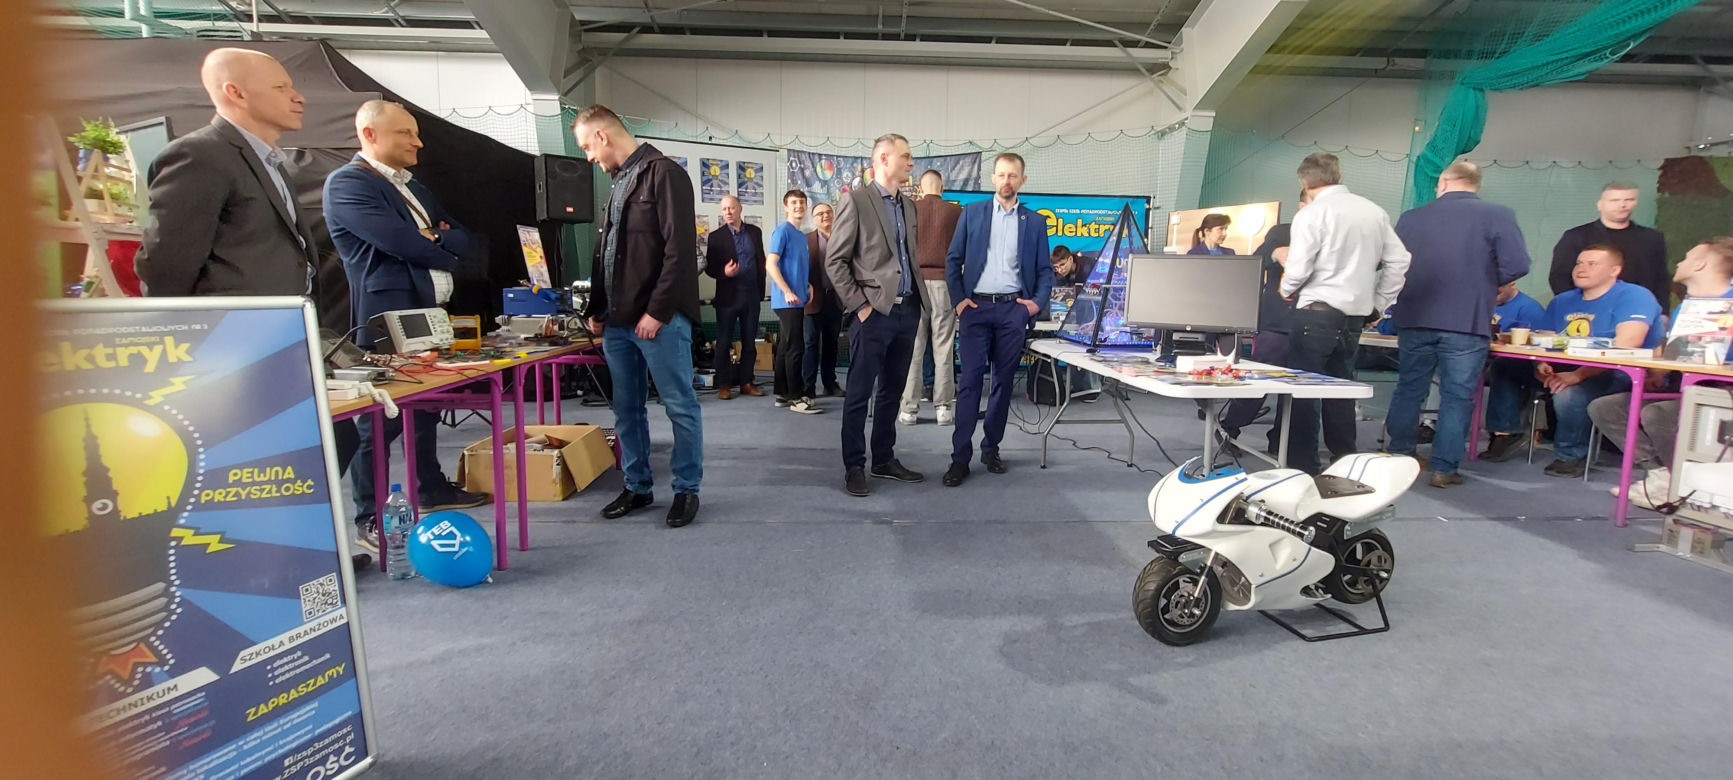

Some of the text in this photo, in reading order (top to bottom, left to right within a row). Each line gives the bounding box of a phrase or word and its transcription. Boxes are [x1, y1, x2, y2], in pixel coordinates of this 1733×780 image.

[39, 335, 193, 373] ektryk
[200, 478, 315, 504] PRZYSZŁOŚĆ
[228, 465, 295, 484] PEWNA
[240, 613, 345, 665] SZKOŁA BRANŻOWA
[98, 683, 179, 721] ECHNIKUM
[246, 662, 346, 722] ZAPRASZAMY
[305, 744, 356, 780] OŚĆ
